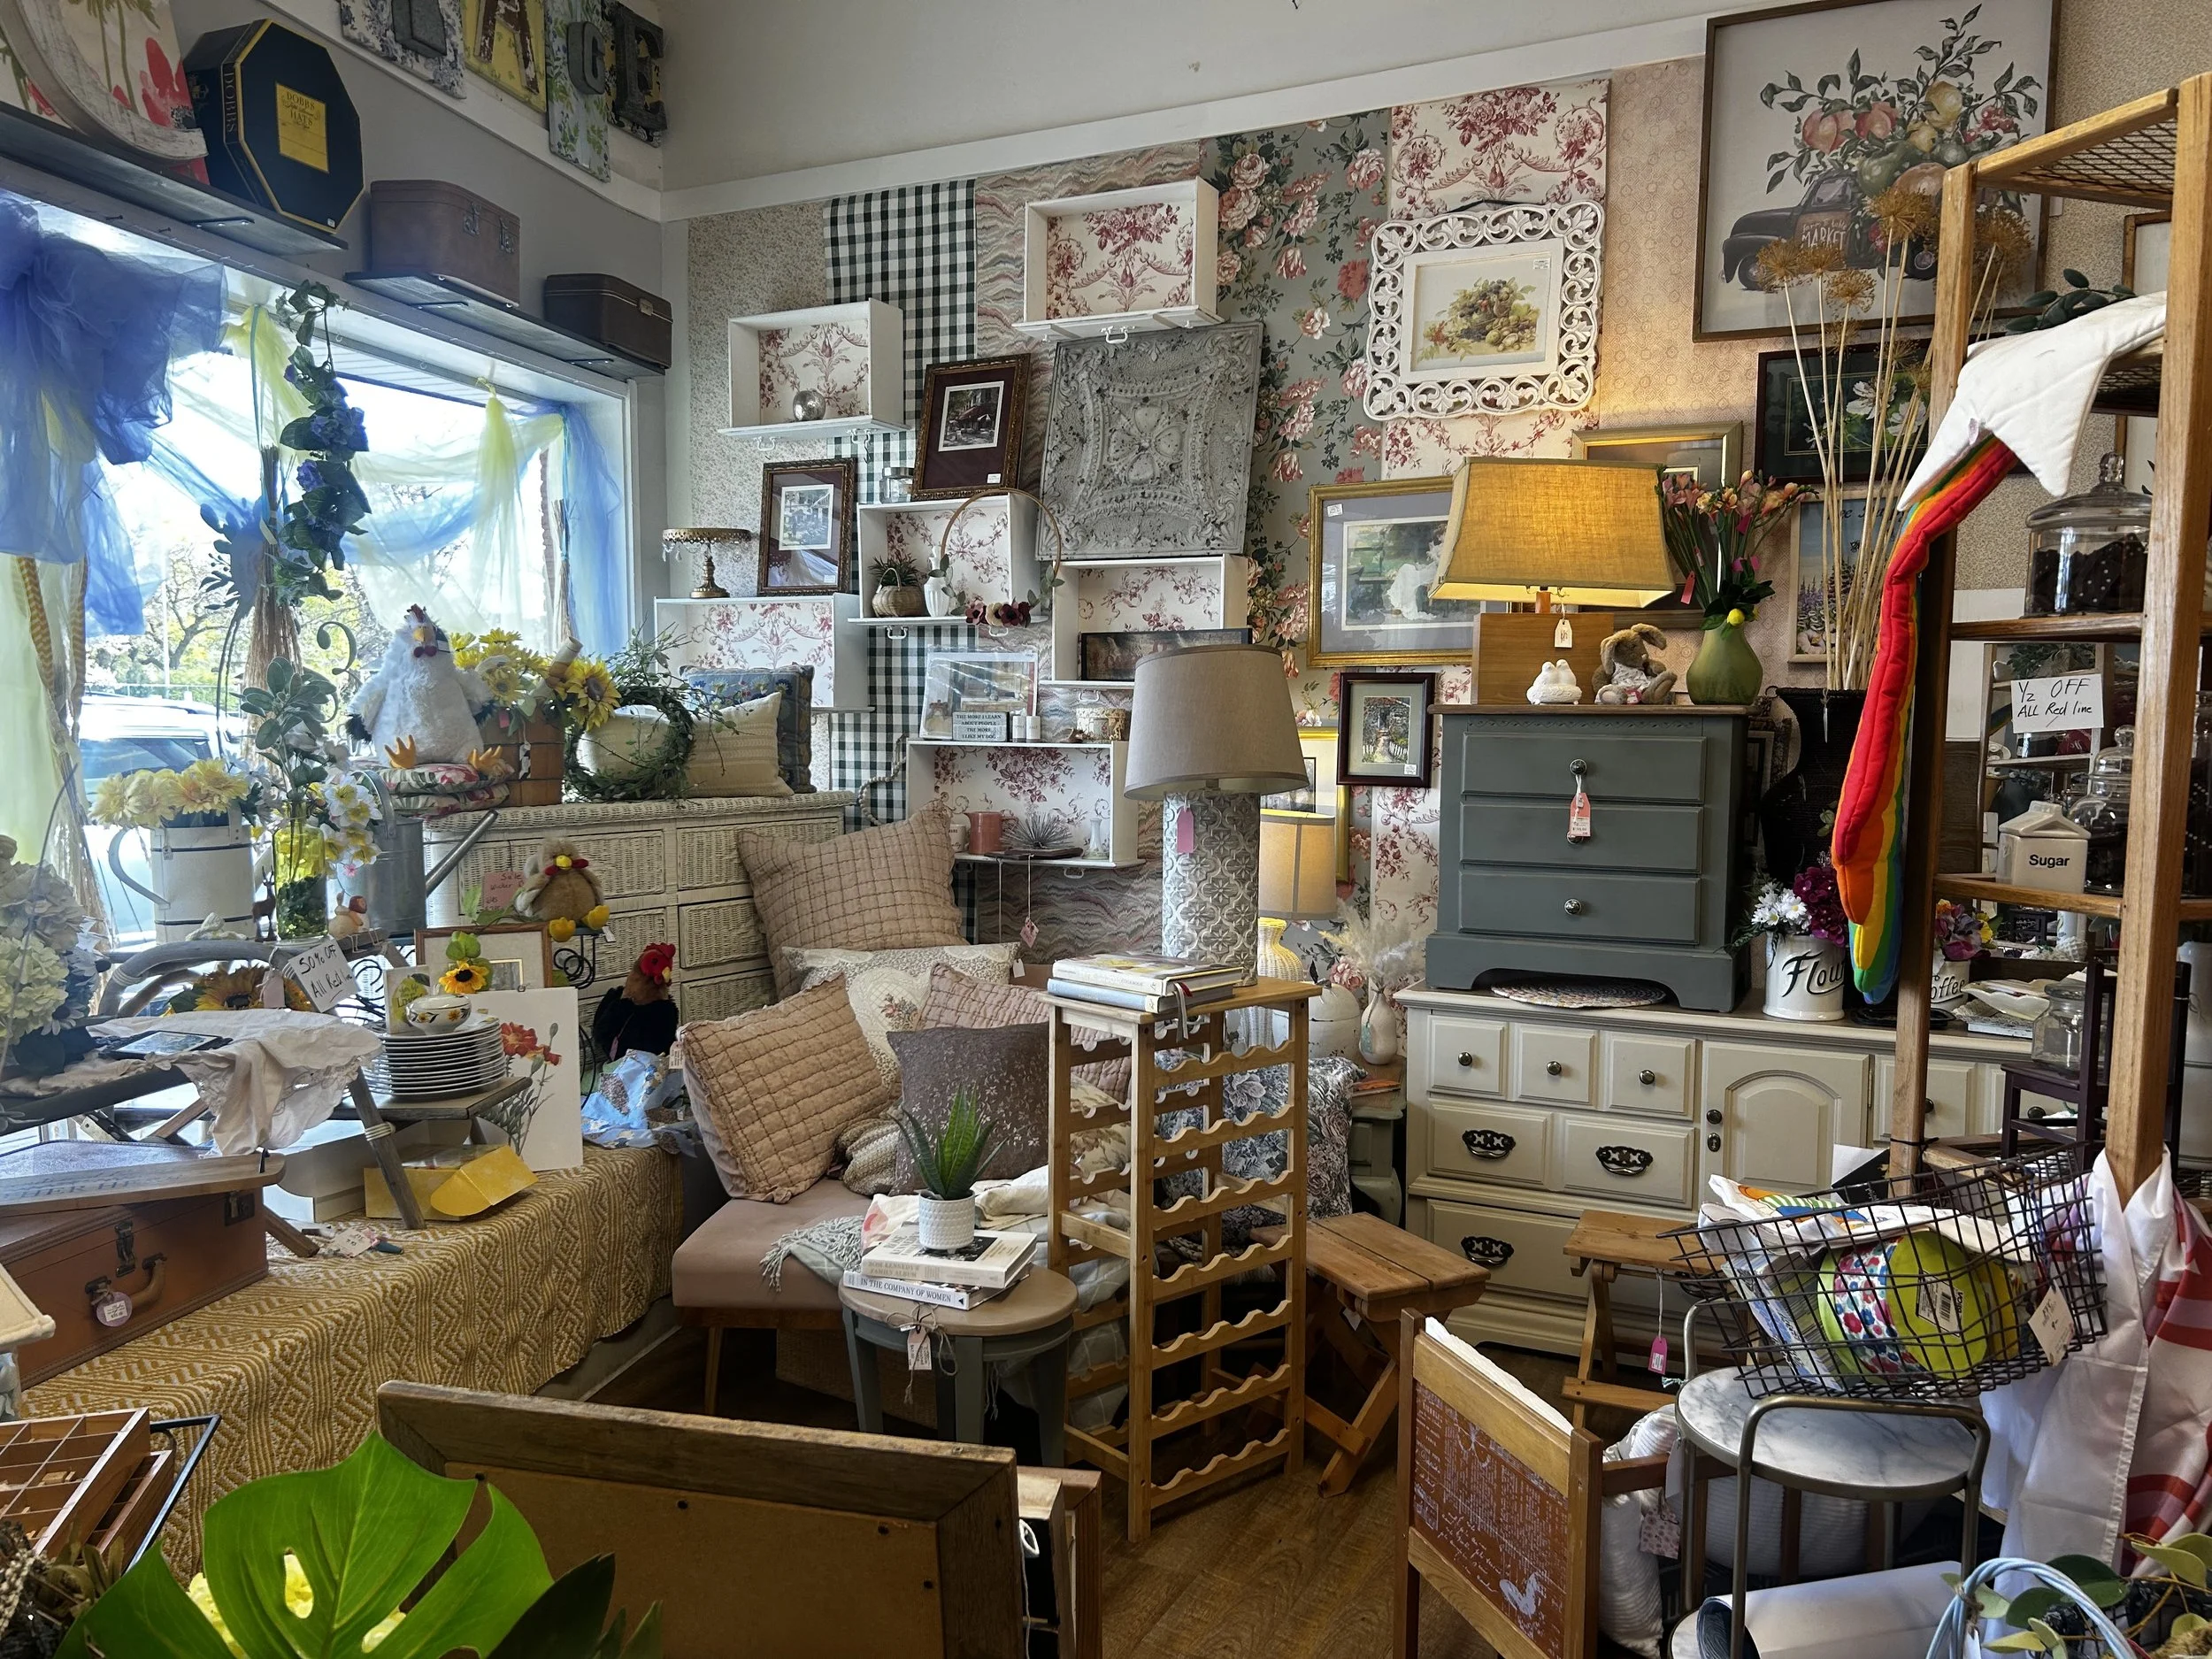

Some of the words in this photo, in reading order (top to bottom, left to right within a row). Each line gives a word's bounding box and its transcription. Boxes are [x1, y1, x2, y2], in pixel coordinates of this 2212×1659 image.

[224, 73, 237, 133] DOBBS
[286, 90, 315, 111] DOBBS
[290, 110, 313, 127] HATS
[1801, 227, 1847, 250] MARKET
[2050, 678, 2091, 698] OFF
[2017, 704, 2039, 718] ALL
[2045, 701, 2069, 716] Red
[2072, 701, 2093, 715] line
[2029, 854, 2070, 869] Sugar
[299, 952, 326, 975] 50%
[311, 980, 327, 998] All
[1931, 974, 1965, 1004] offee
[868, 1279, 883, 1288] THE
[884, 1282, 915, 1295] COMPANY
[926, 1289, 952, 1302] WOMEN
